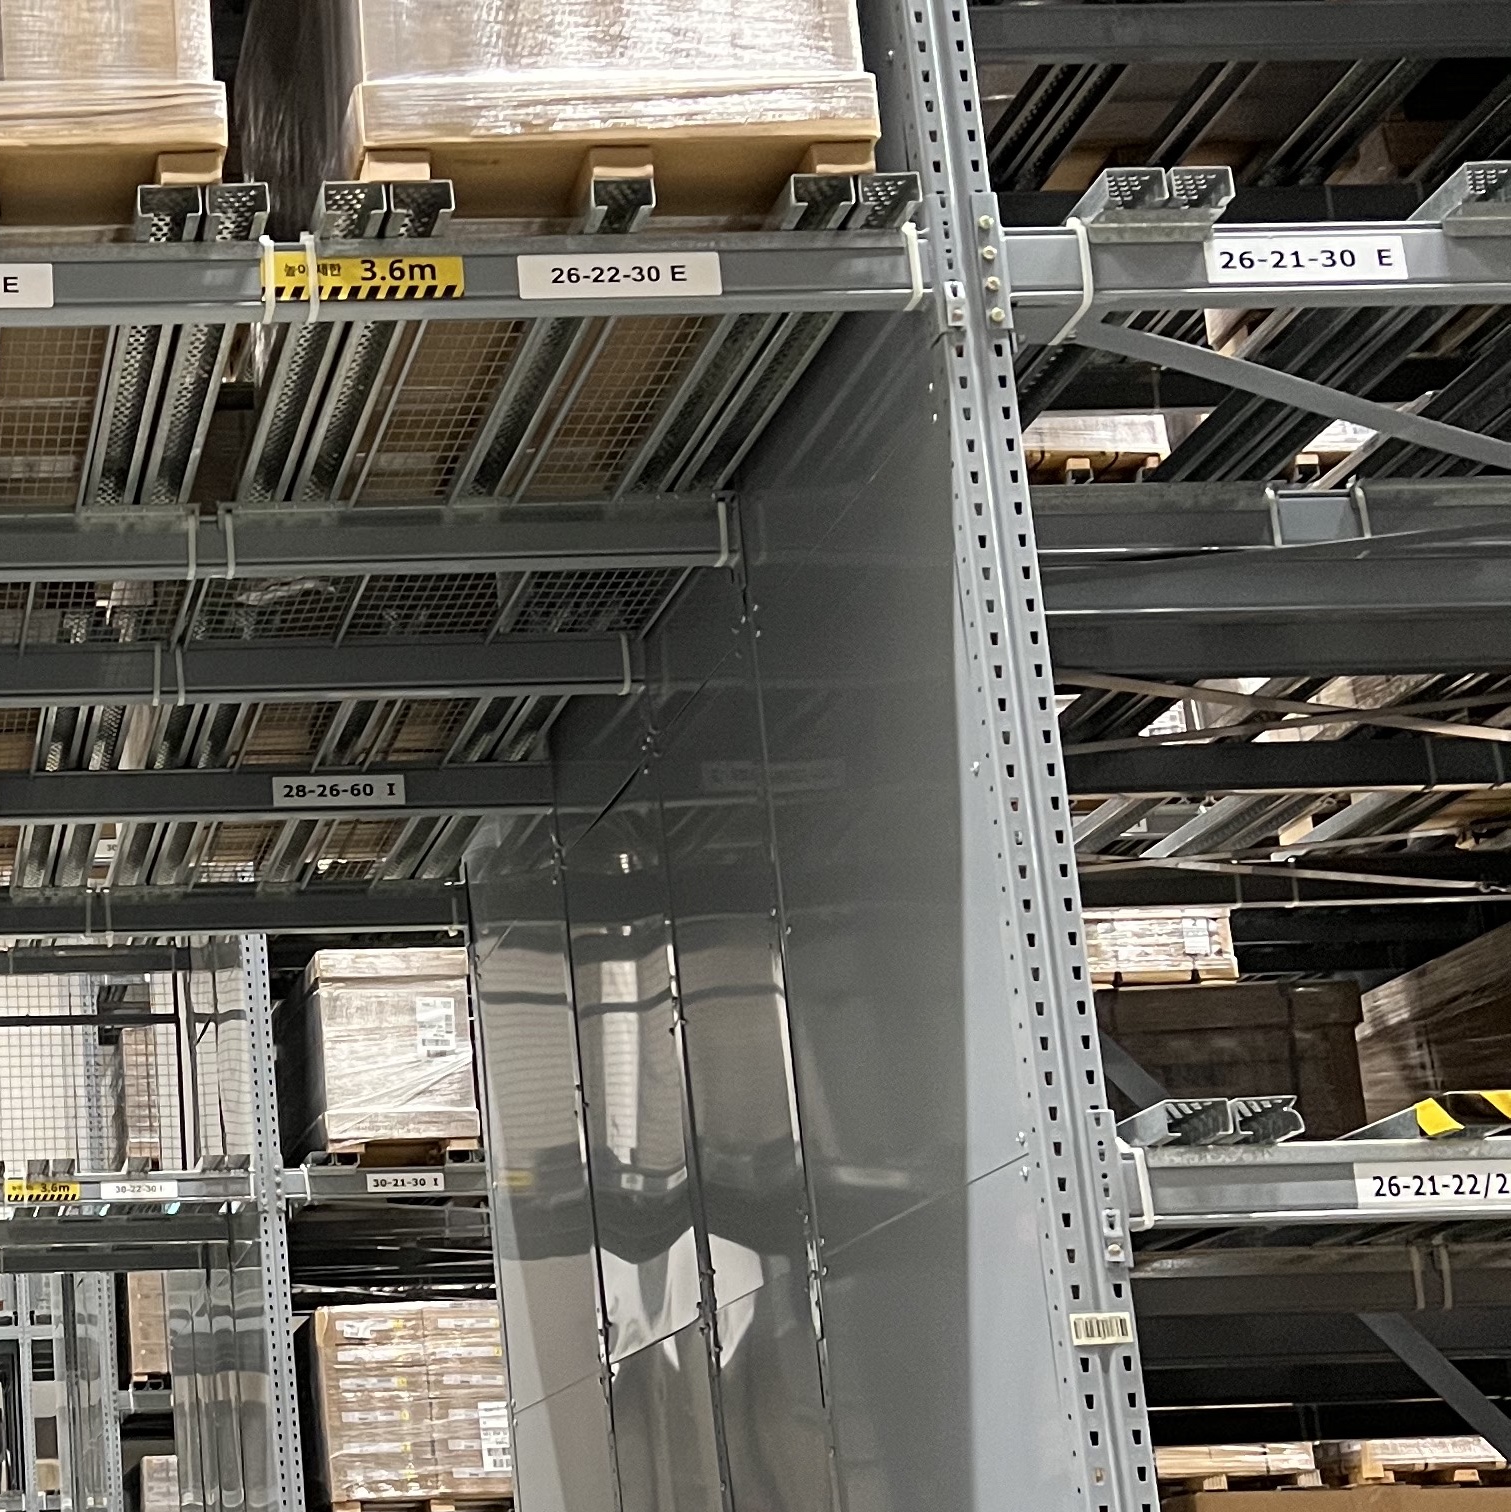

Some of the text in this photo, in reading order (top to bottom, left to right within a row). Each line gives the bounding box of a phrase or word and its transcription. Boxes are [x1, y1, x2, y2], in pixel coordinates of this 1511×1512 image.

[1219, 248, 1393, 269] 26-21-30 E
[360, 259, 436, 281] 3.6m
[551, 264, 687, 284] 26-22-30 E
[3, 276, 19, 293] E
[283, 782, 395, 798] 28-26-60 I
[40, 1183, 70, 1192] 3.6m
[373, 1177, 426, 1187] 30-21-30
[1373, 1172, 1510, 1199] 26-21-22/2
